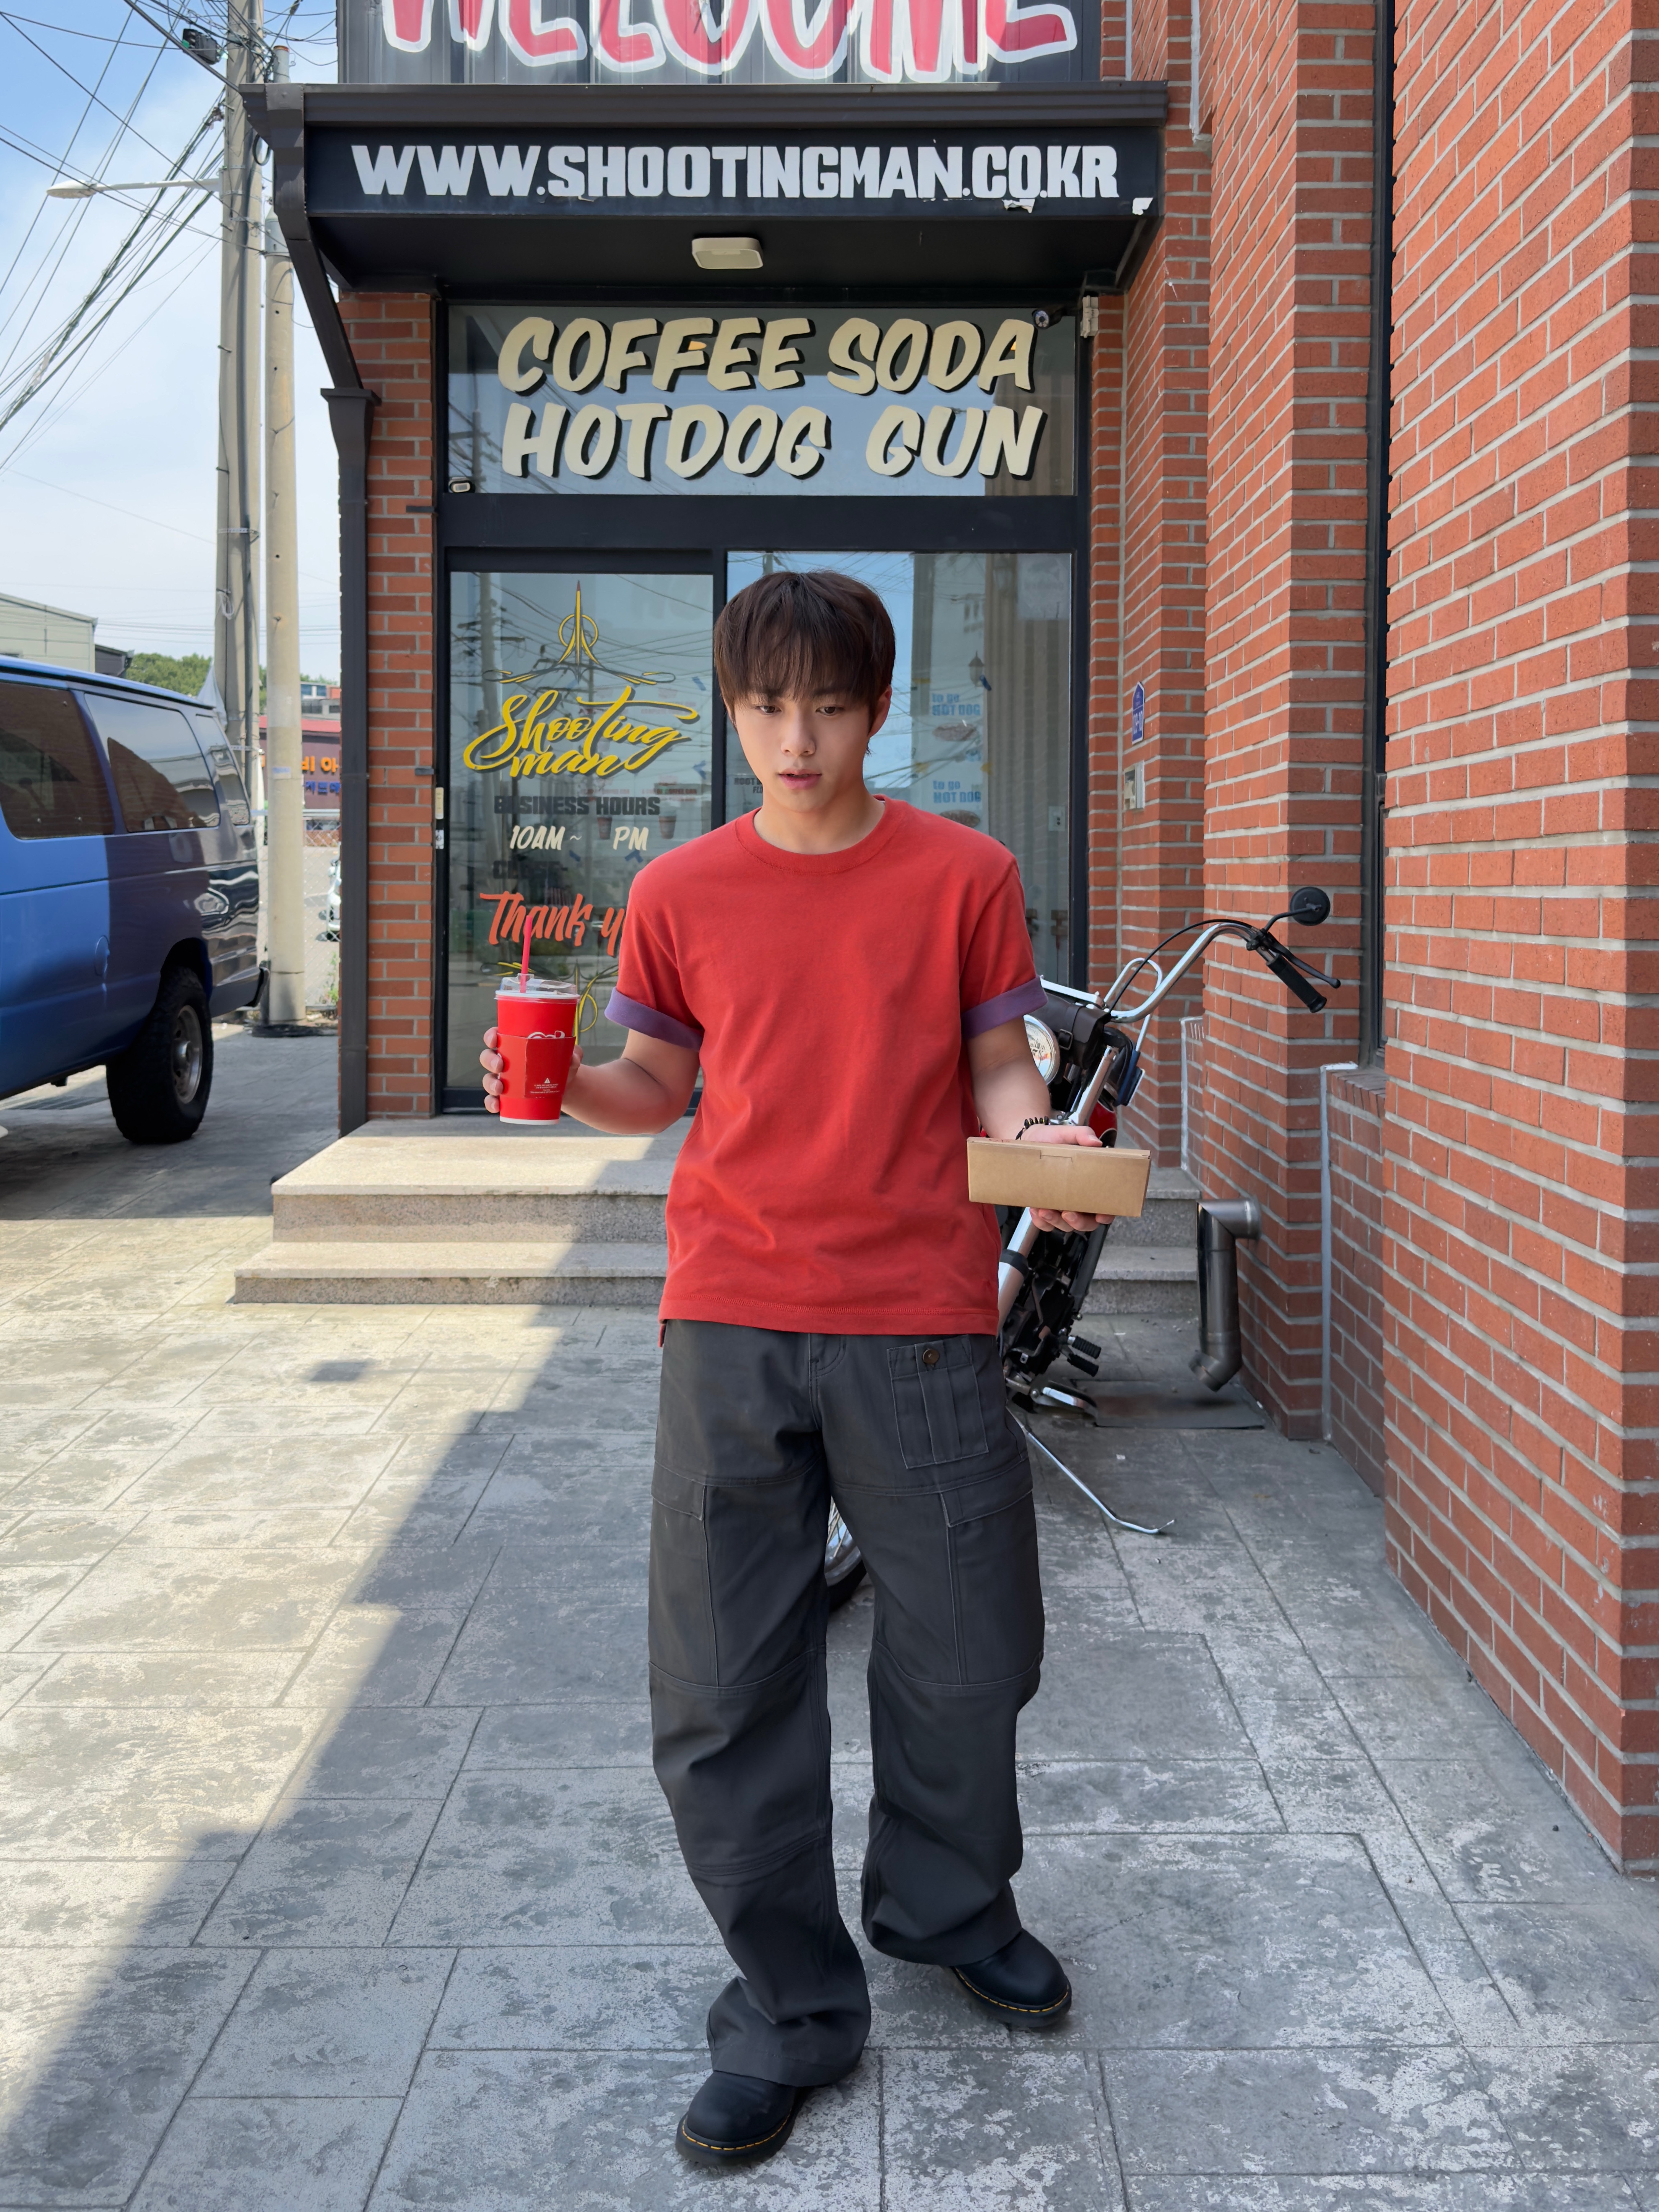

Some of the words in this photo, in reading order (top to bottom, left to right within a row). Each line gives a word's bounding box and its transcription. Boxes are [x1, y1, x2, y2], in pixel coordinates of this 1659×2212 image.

[351, 145, 1119, 198] WWW.SHOOTINGMAN.CO.KR
[498, 317, 815, 396] COFFEE
[827, 317, 1037, 396] SODA
[502, 402, 831, 481] HOTDOG
[866, 404, 1048, 481] GUN
[932, 704, 955, 716] HOT
[958, 704, 981, 716] DOG
[463, 686, 700, 772] Shooting
[509, 750, 625, 778] man
[933, 780, 944, 790] to
[947, 781, 960, 791] go
[933, 792, 957, 803] HOT
[959, 791, 981, 803] DOG
[494, 796, 589, 815] BUSINESS
[596, 796, 661, 815] HOURS
[509, 825, 565, 851] 10AM
[613, 826, 649, 851] PM
[479, 891, 593, 947] Thank
